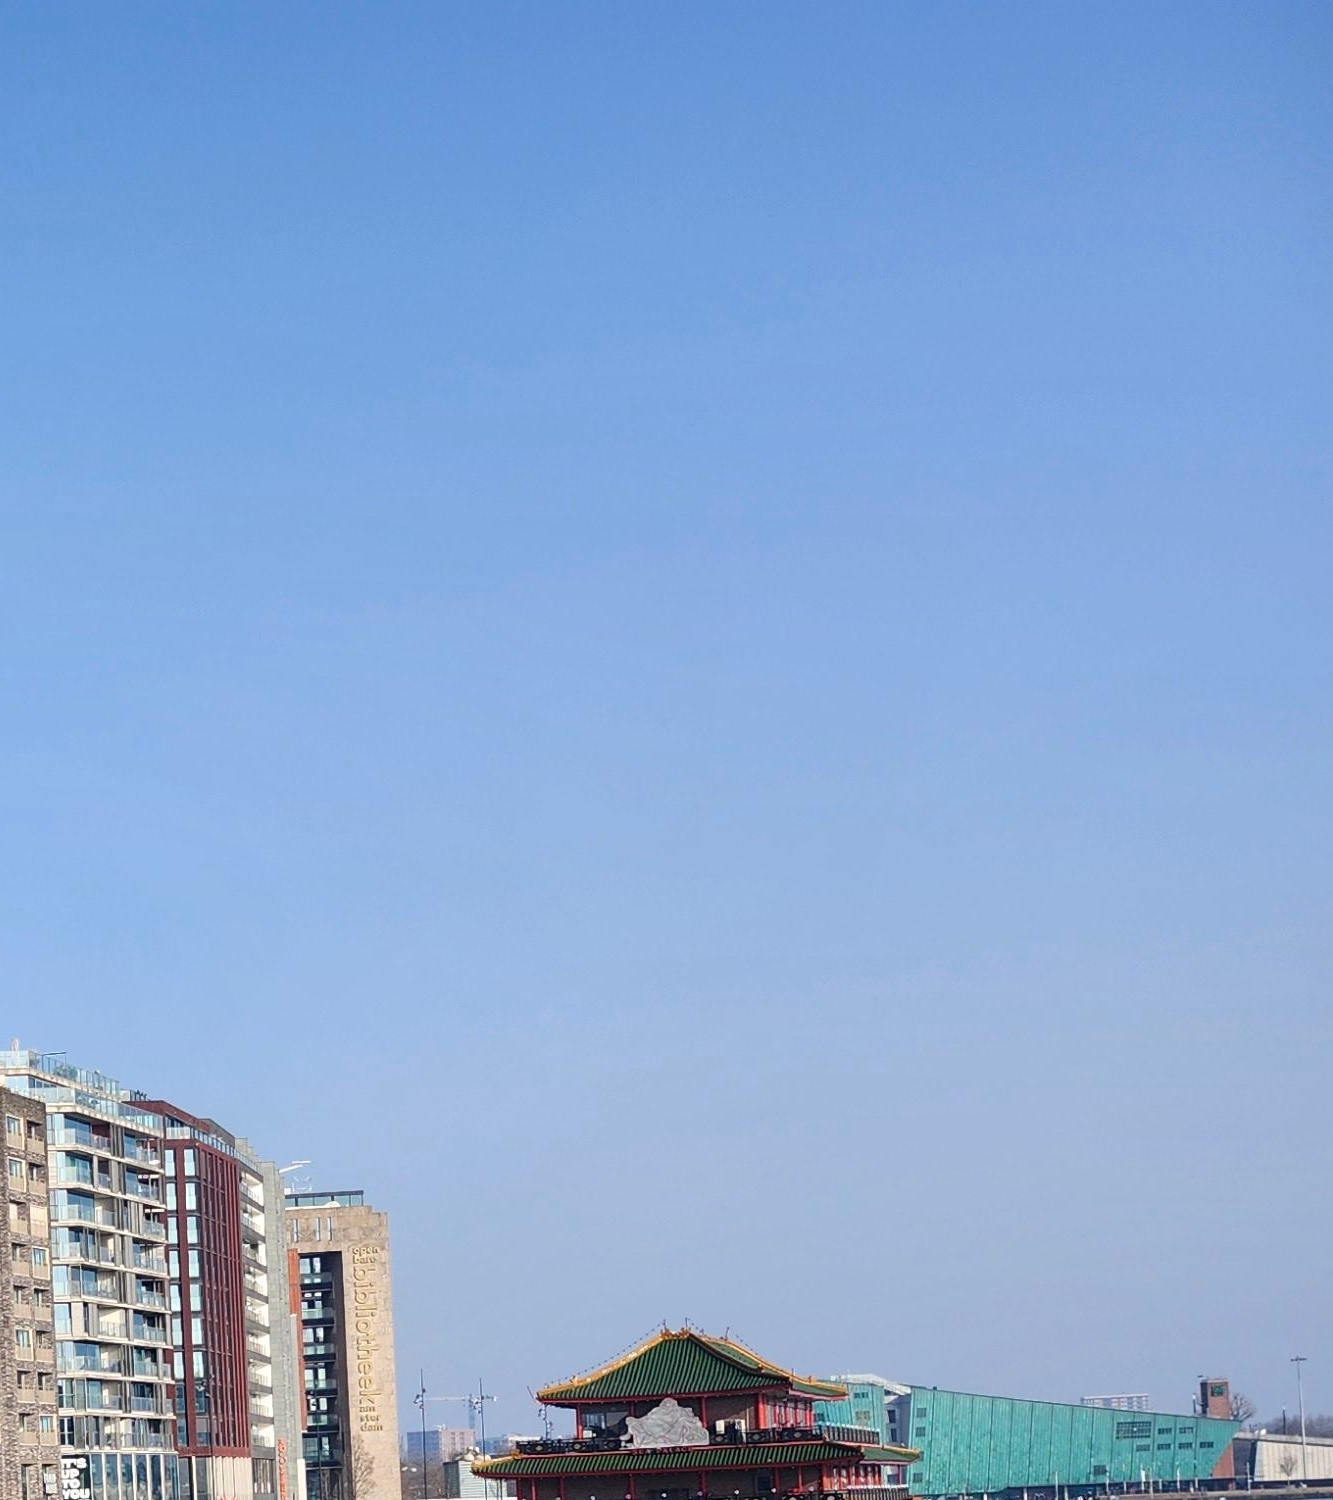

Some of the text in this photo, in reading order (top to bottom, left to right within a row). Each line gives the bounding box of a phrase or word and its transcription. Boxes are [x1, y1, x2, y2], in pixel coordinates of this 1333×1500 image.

[353, 1266, 382, 1405] bibliotheek
[61, 1469, 80, 1478] UP
[62, 1478, 80, 1488] TO
[63, 1488, 90, 1499] YOU
